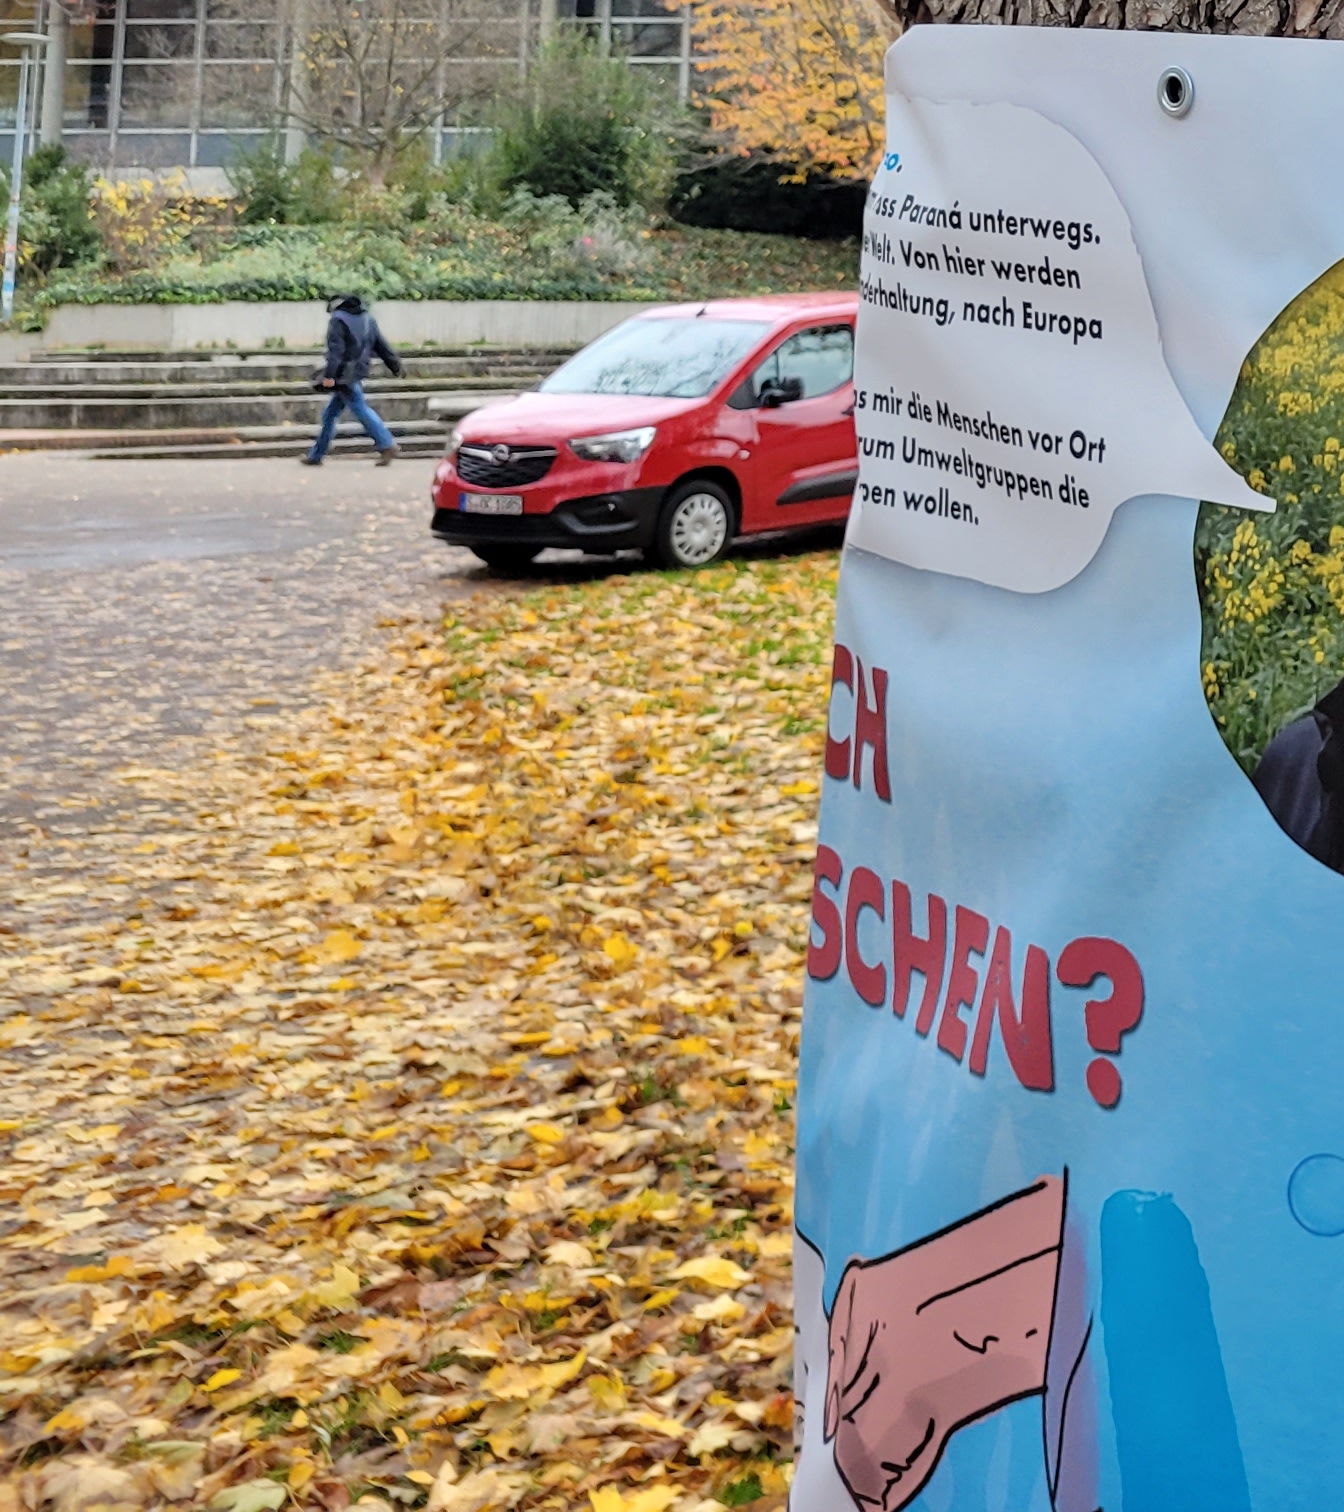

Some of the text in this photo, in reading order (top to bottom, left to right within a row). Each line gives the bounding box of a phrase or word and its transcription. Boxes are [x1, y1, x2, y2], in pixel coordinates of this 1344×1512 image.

[898, 193, 962, 230] Paraná
[969, 209, 1101, 250] unterwegs.
[899, 240, 940, 271] Von
[942, 244, 986, 277] hier
[991, 256, 1082, 289] werden
[963, 296, 1015, 327] nach
[1022, 301, 1103, 345] Europa
[872, 386, 903, 416] mir
[907, 391, 933, 423] die
[936, 400, 1023, 448] Menschen
[1027, 430, 1063, 455] vor
[1069, 430, 1106, 464] Ort
[902, 436, 1053, 501] Umweltgruppen
[1059, 474, 1090, 509] die
[903, 487, 979, 526] wollen.
[807, 844, 1145, 1109] SCHEN?
